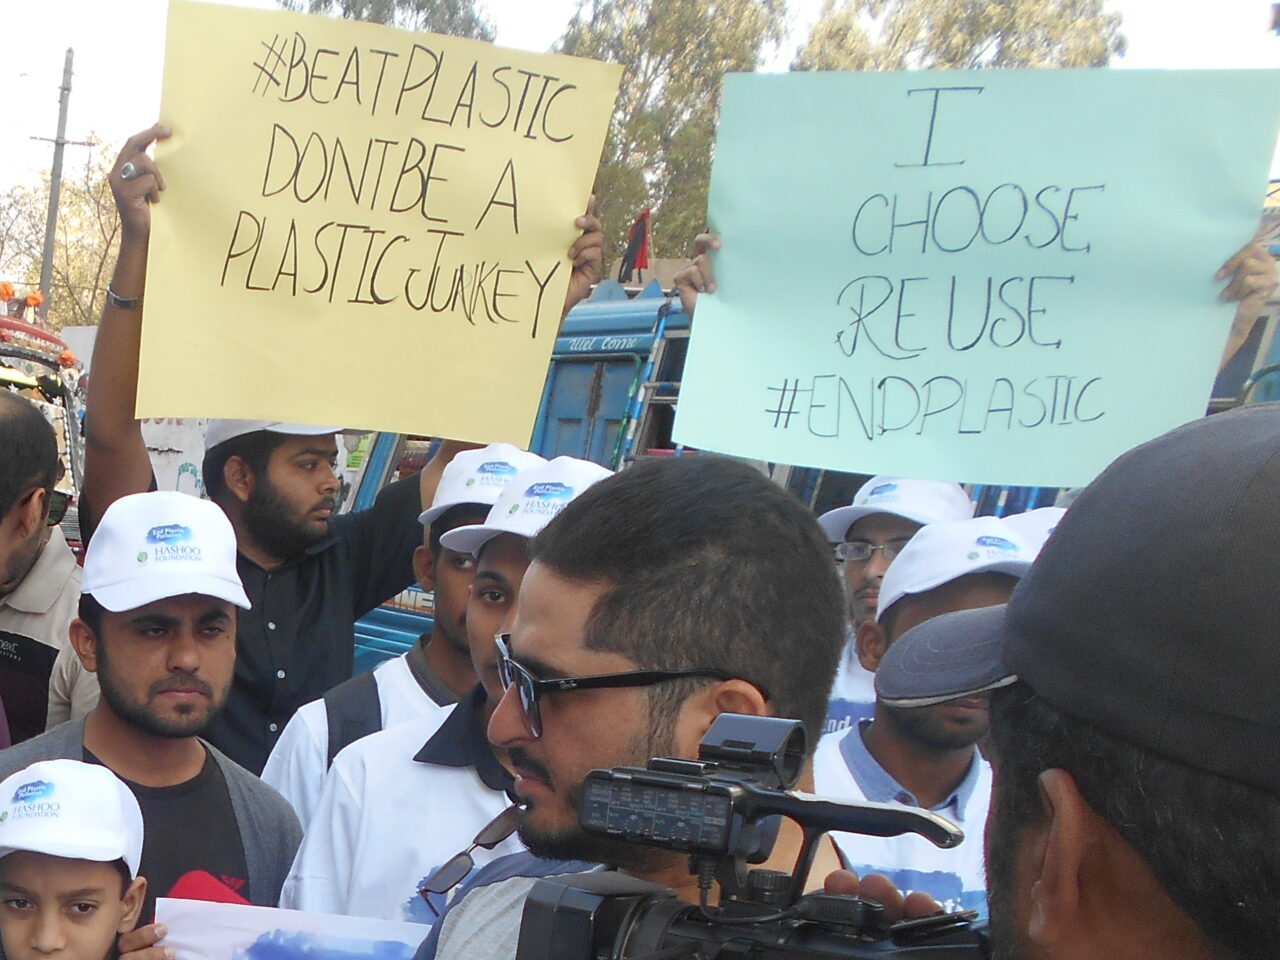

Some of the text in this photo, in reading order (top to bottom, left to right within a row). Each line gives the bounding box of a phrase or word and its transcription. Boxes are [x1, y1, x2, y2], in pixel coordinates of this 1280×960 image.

[893, 86, 985, 168] I
[475, 158, 519, 234] A
[852, 182, 1107, 256] CHOOSE
[155, 545, 201, 556] HASHOO
[13, 802, 61, 815] HASHOO
